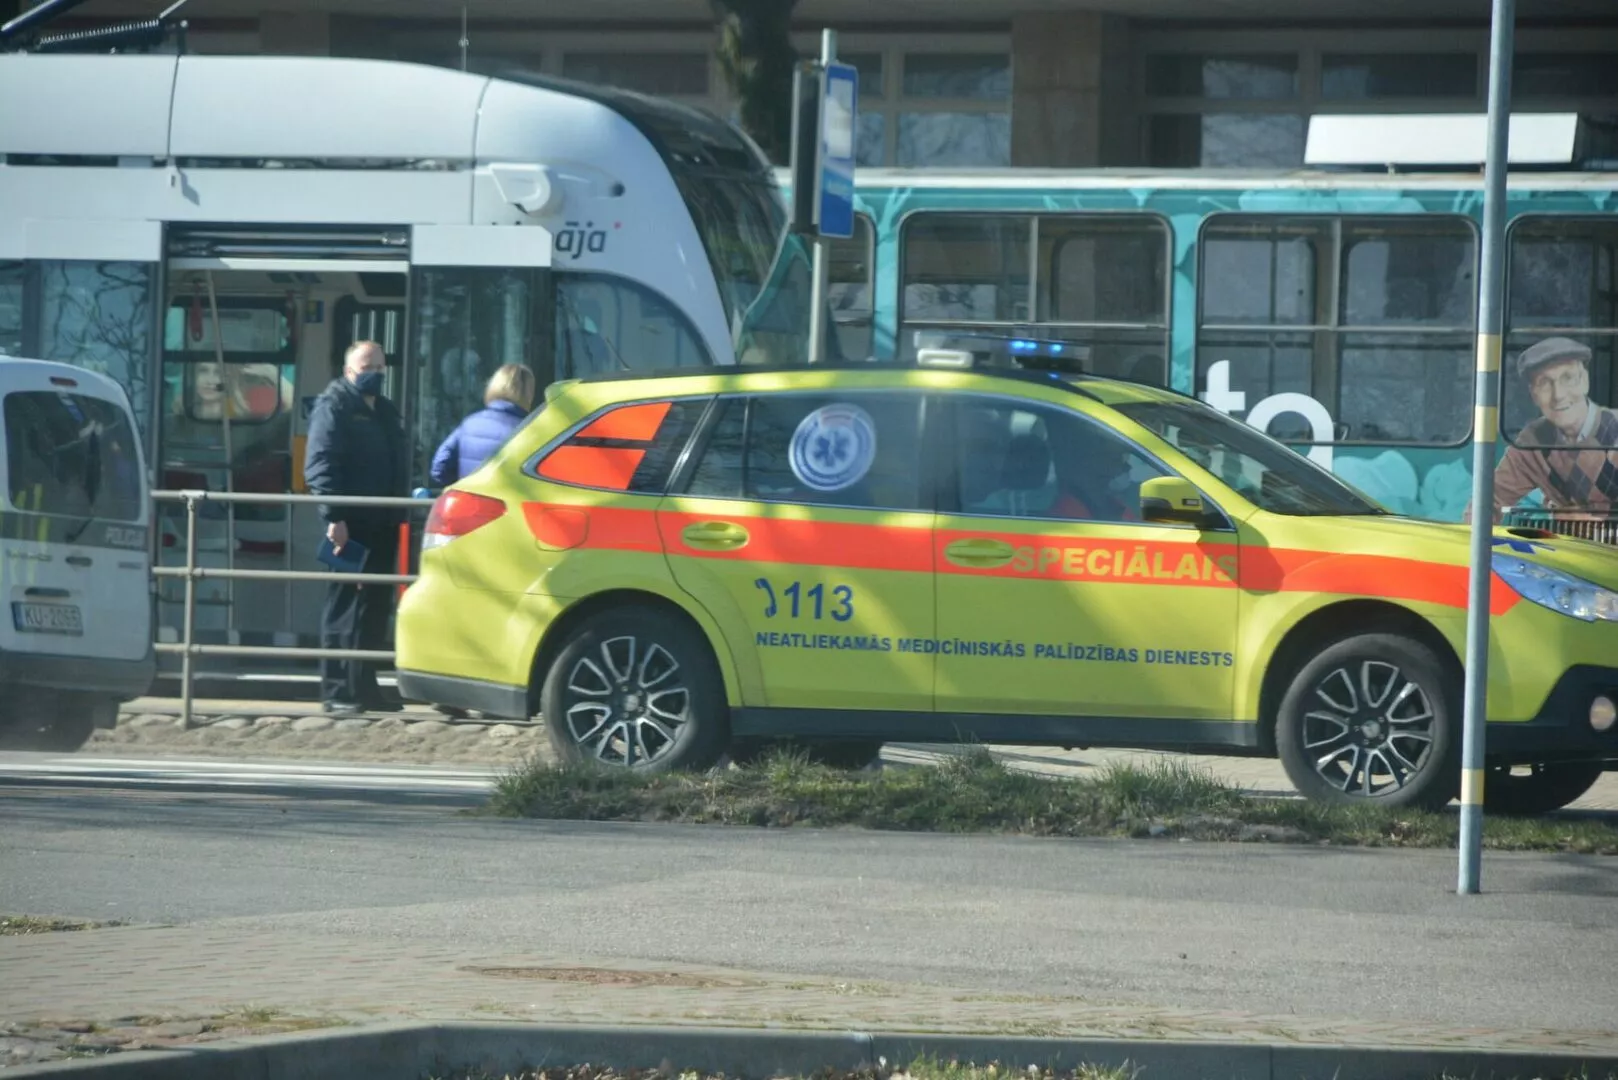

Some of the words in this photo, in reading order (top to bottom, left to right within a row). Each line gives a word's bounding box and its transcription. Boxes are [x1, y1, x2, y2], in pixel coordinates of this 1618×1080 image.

[1011, 545, 1238, 582] SPECIĀLAIS
[784, 580, 854, 623] 113
[756, 631, 892, 652] NEATLIEKAMĀS
[897, 637, 1026, 657] MEDICĪNISKĀS
[1034, 642, 1139, 663] PALĪDZĪBAS
[1145, 649, 1234, 667] DIENESTS
